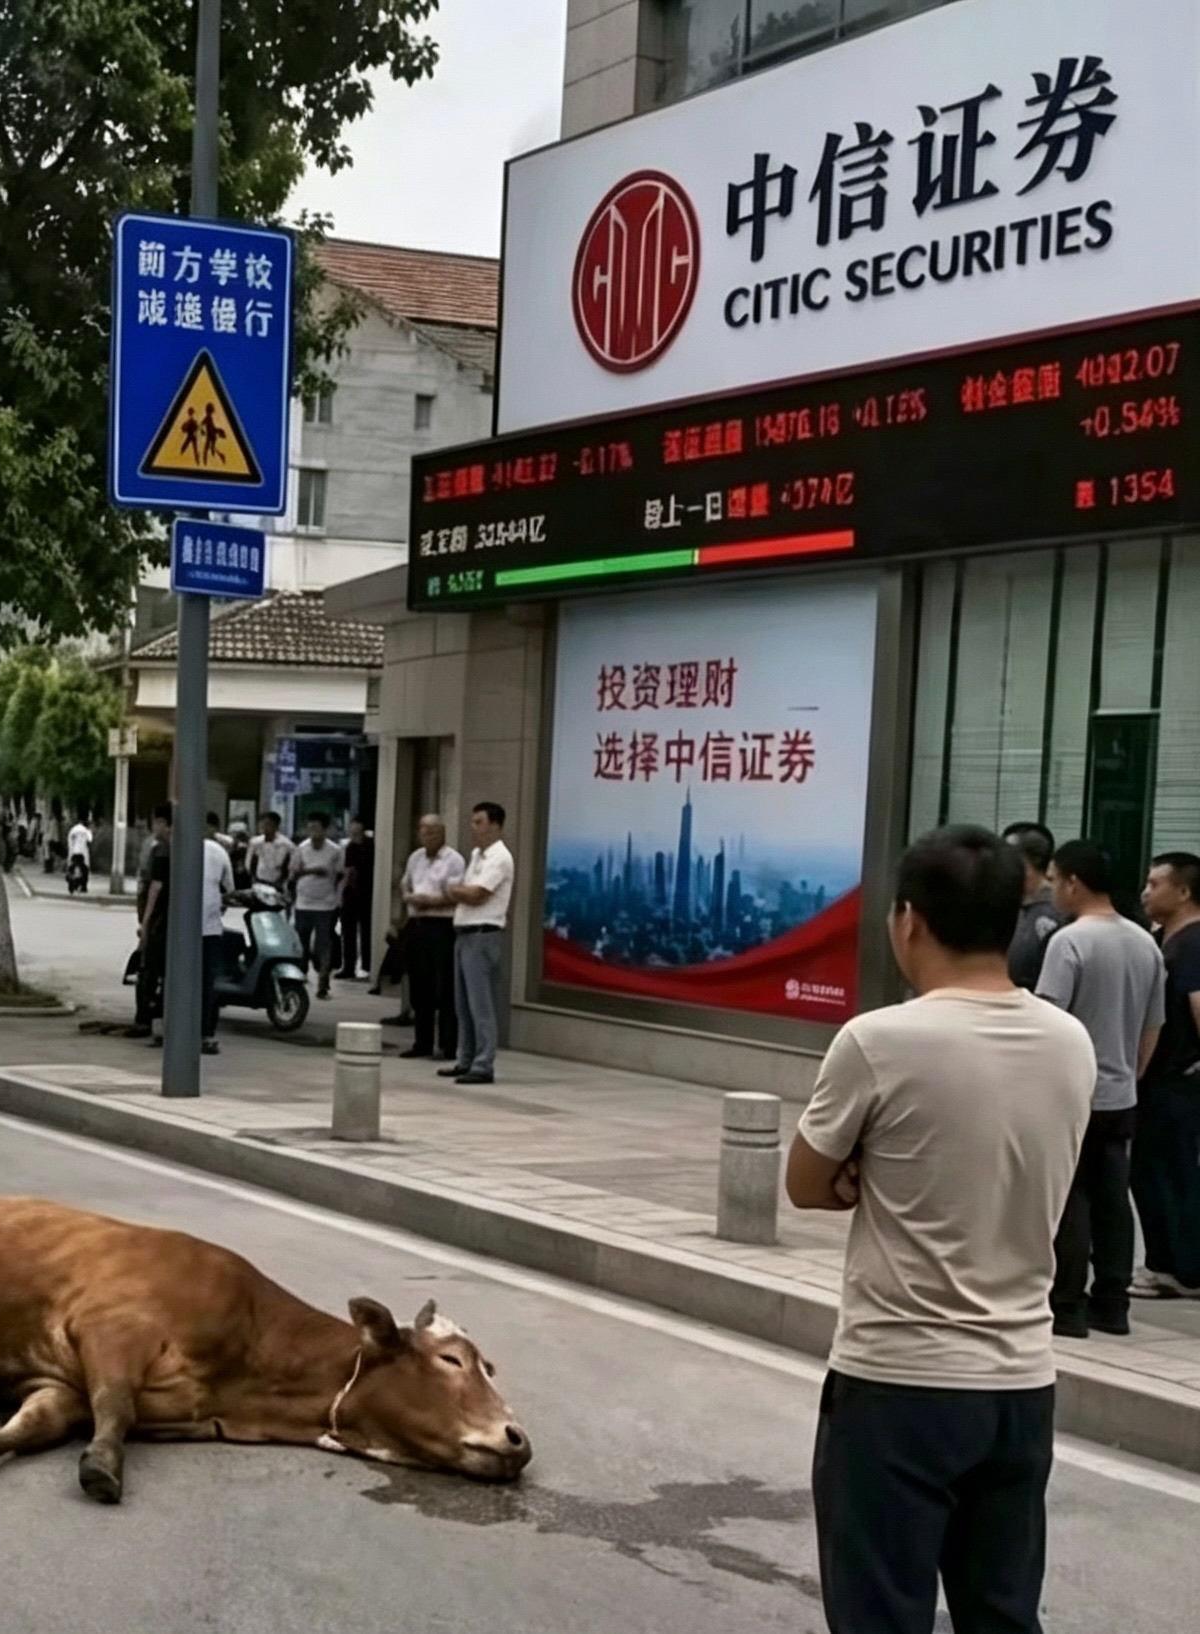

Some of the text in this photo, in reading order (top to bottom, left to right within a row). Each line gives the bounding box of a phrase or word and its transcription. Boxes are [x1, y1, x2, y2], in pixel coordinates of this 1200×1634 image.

[726, 55, 1119, 263] 中信证券
[724, 200, 1113, 328] CITIC SECURITIES
[1110, 469, 1175, 506] 1354
[596, 657, 738, 712] 投资理财
[593, 728, 816, 784] 选择中信证券
